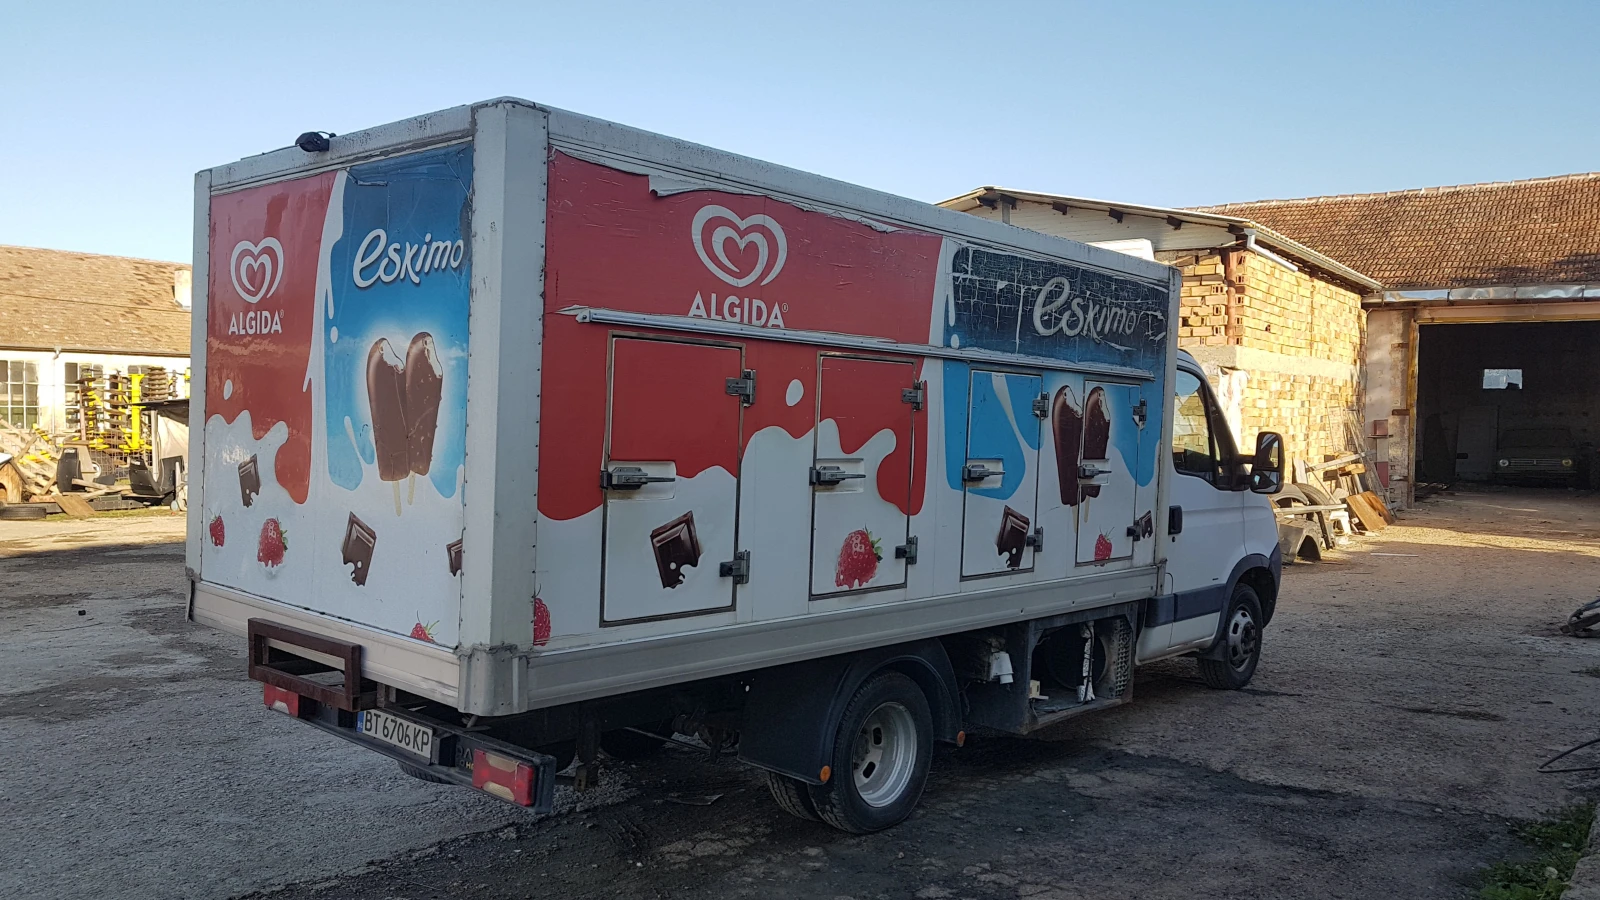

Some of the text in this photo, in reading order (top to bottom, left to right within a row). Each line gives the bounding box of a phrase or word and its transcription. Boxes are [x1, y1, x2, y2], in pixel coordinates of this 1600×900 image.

[228, 309, 283, 336] ALGIDA
[687, 290, 785, 328] ALGIDA
[364, 710, 430, 752] BT 6706 KP
